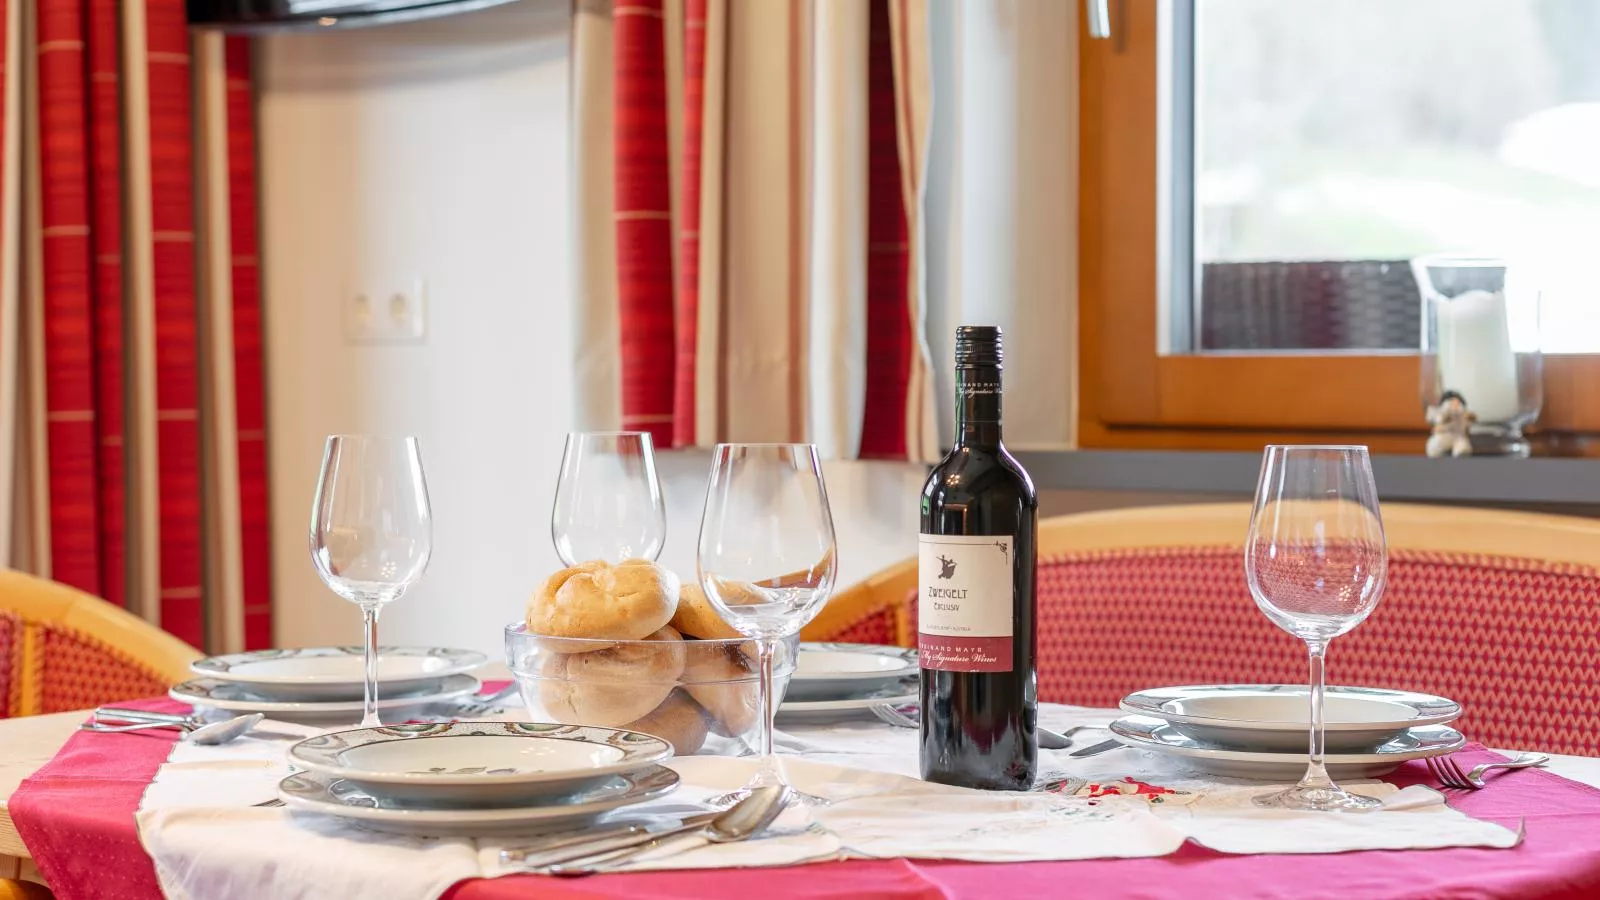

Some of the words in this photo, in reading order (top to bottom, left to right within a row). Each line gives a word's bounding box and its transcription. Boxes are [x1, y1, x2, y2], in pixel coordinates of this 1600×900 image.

[928, 586, 968, 599] ZWEIGELT
[932, 652, 970, 667] Signature
[971, 653, 997, 663] Wines
